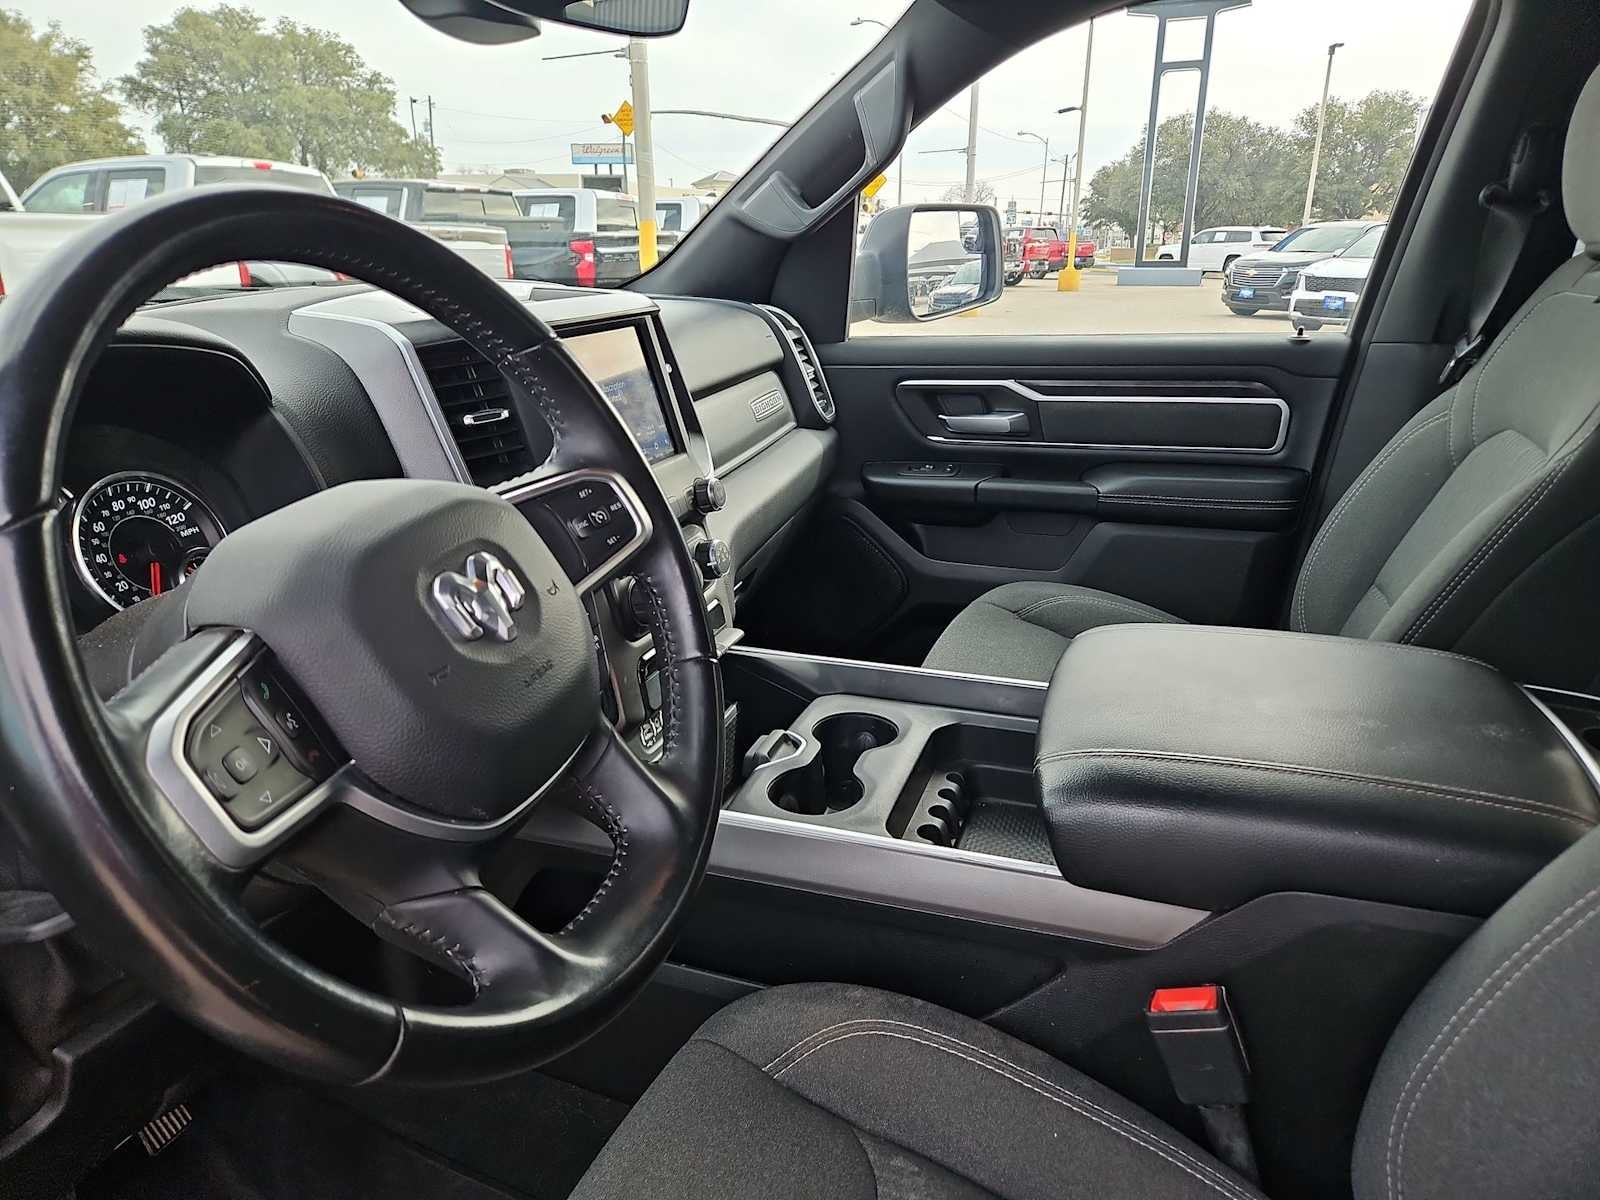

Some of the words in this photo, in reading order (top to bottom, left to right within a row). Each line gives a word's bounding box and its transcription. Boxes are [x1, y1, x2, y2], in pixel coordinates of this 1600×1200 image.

[111, 500, 126, 512] 80
[137, 497, 156, 510] 100
[159, 503, 171, 511] 110
[166, 512, 186, 526] 120
[92, 521, 106, 533] 60
[180, 526, 200, 538] MPH
[95, 553, 108, 564] 40
[115, 580, 129, 593] 20
